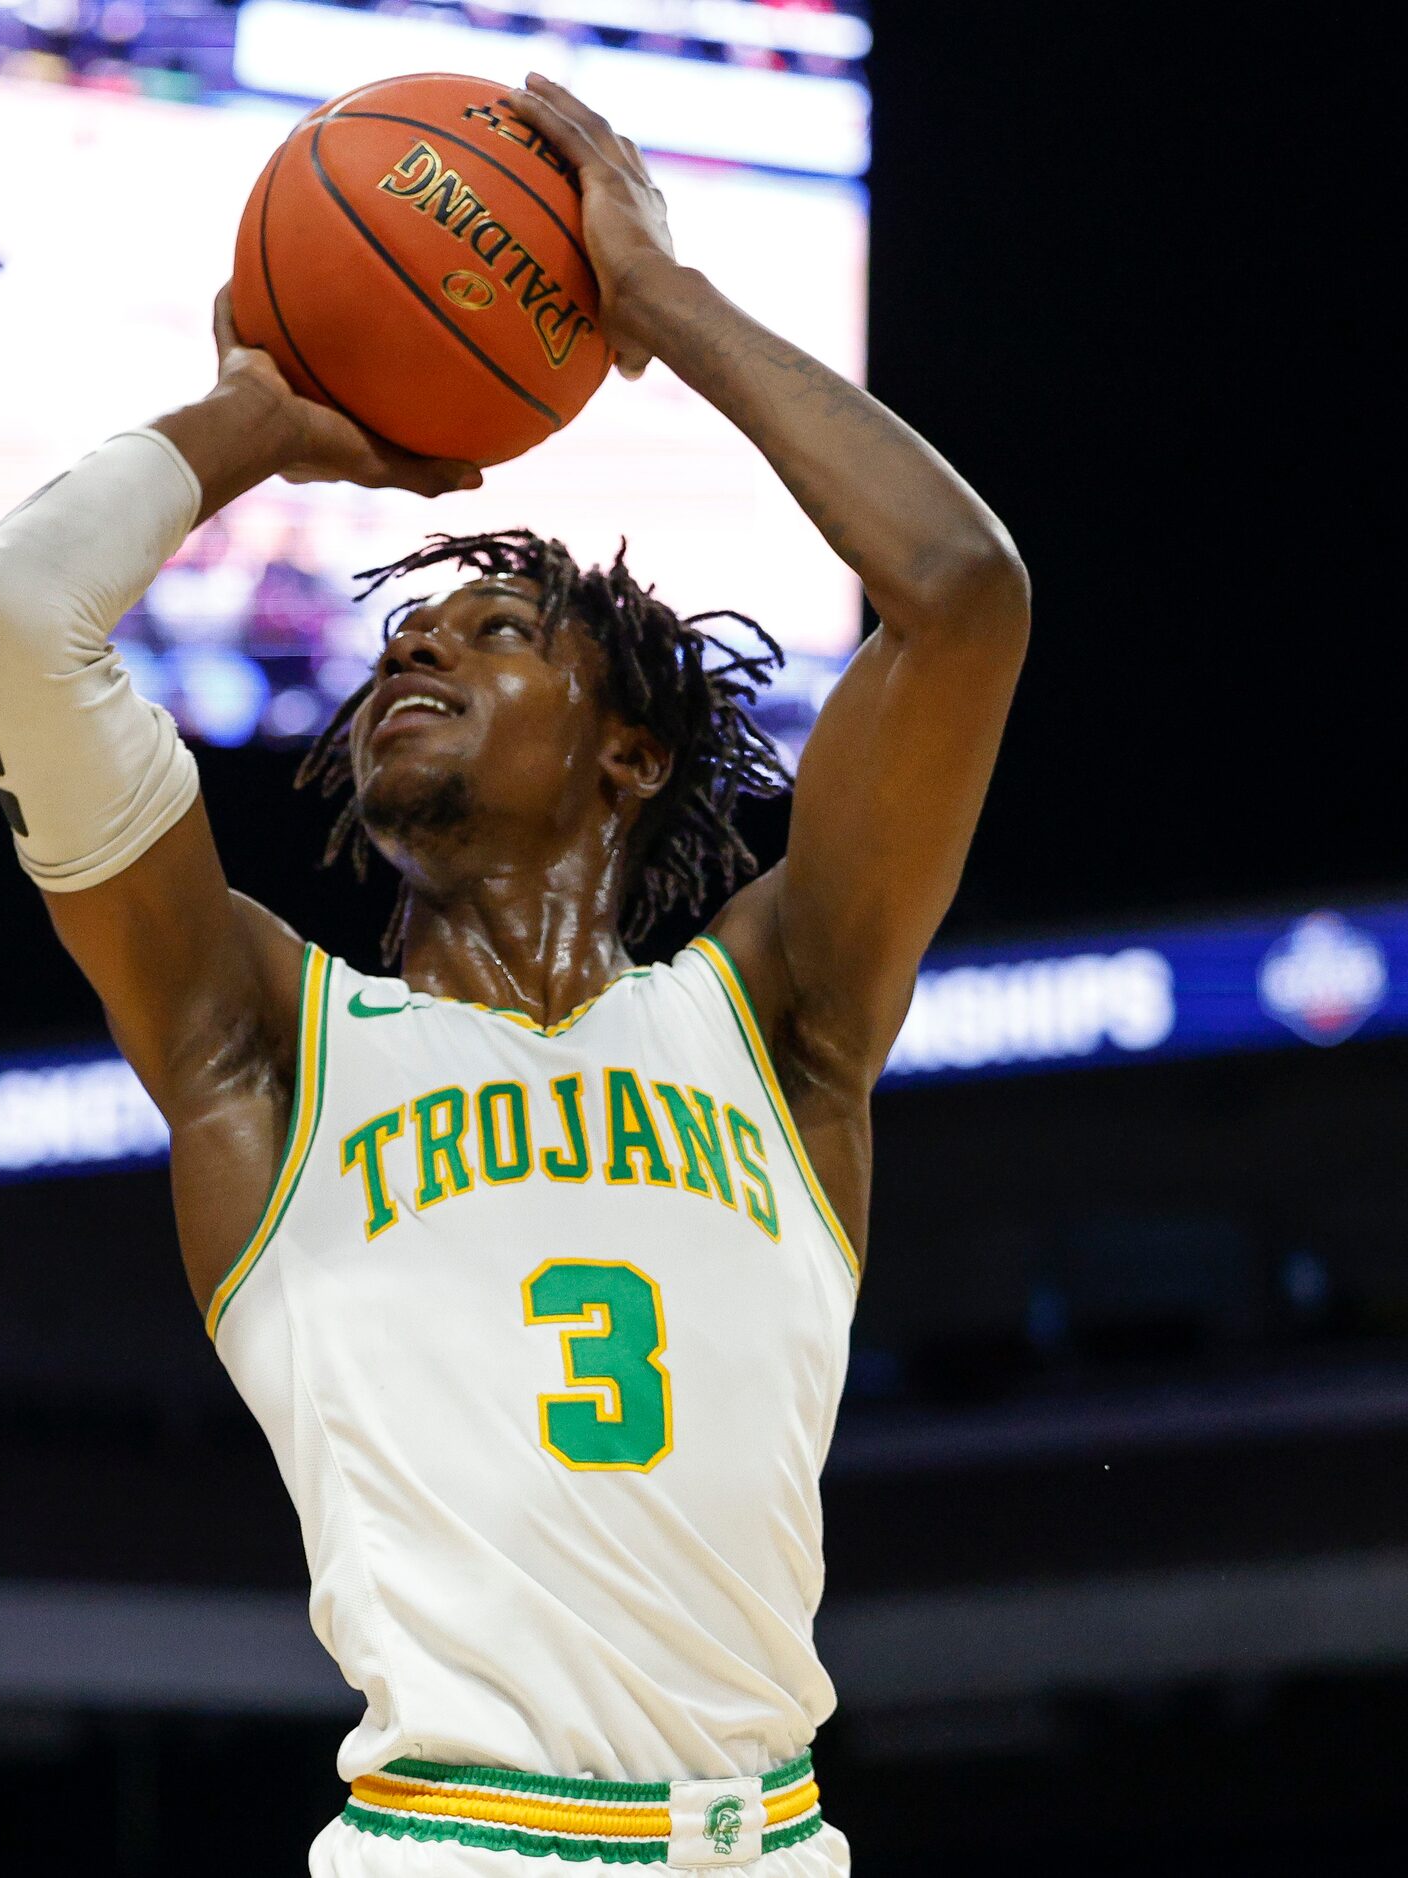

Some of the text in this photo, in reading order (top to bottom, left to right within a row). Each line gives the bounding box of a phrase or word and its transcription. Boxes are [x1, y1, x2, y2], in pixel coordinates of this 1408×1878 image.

[377, 140, 594, 369] SPALDING
[340, 1066, 781, 1243] TROJANS
[521, 1257, 673, 1473] 3
